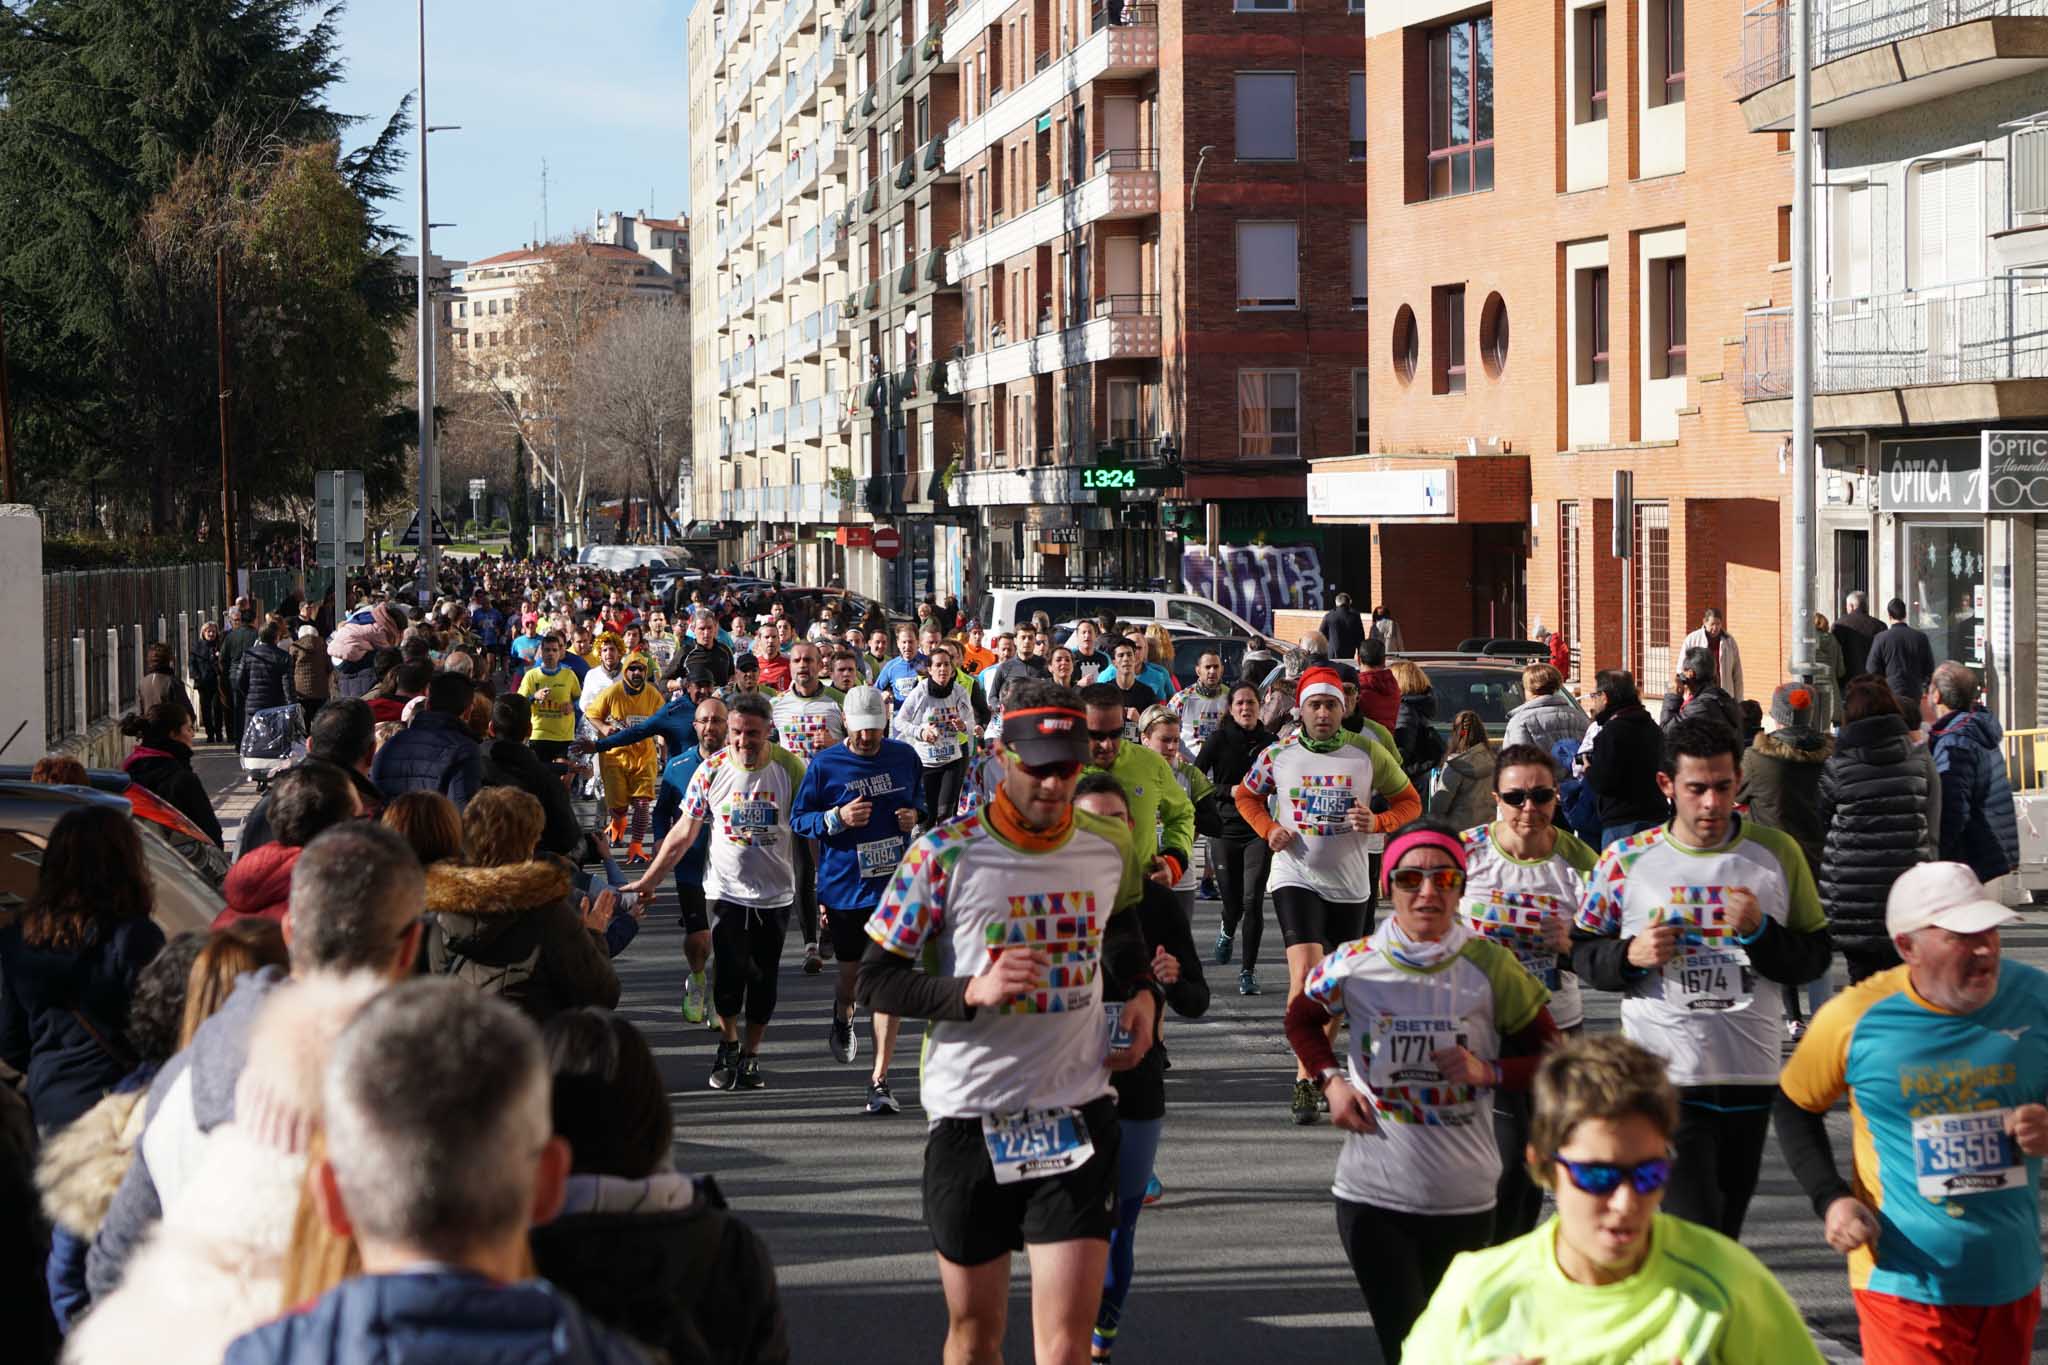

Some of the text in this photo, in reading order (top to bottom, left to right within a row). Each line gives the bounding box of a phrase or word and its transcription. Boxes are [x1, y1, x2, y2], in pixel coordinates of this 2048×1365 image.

[1083, 470, 1135, 488] 13:24
[1890, 446, 1952, 503] ÓPTICA
[1052, 534, 1077, 542] BAR
[846, 777, 869, 792] WHAT
[870, 773, 891, 786] DOES
[1312, 797, 1345, 812] 4035
[738, 809, 766, 823] 3481
[865, 847, 896, 866] 3094
[1681, 968, 1728, 995] 1674
[1395, 1020, 1459, 1032] SETEL
[1391, 1035, 1435, 1063] 1771
[1001, 1121, 1061, 1158] 2257
[1930, 1135, 2001, 1170] 3556
